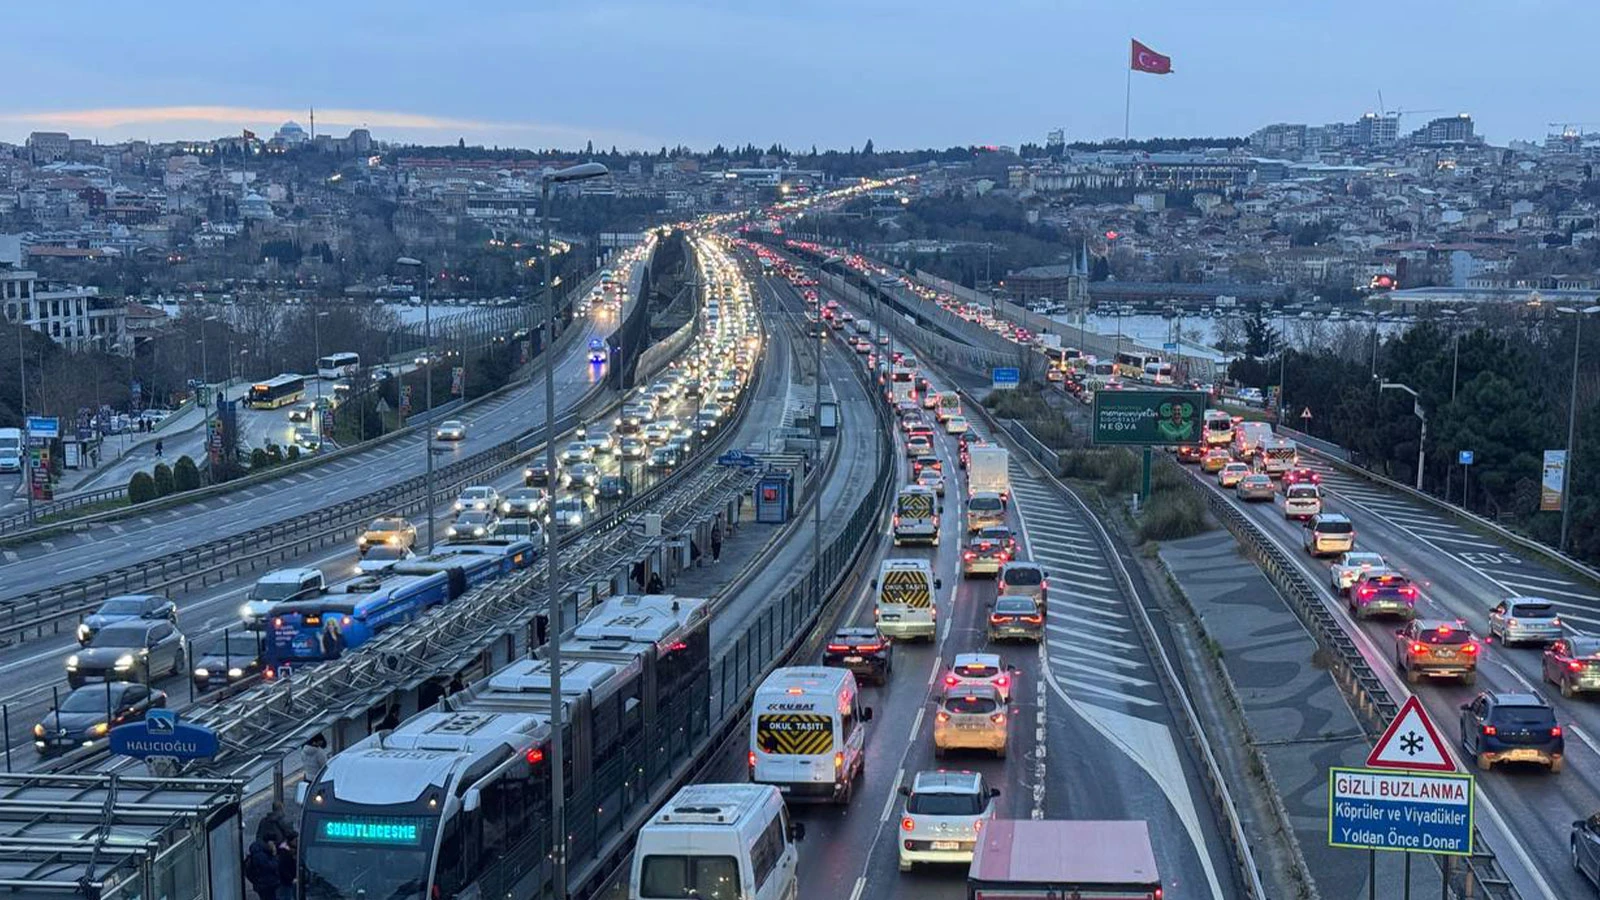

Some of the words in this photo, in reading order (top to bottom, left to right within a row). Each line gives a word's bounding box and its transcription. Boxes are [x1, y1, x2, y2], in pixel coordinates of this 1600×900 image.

[1099, 422, 1137, 431] NEOVA
[1458, 552, 1522, 564] EDS
[769, 722, 792, 731] OKUL
[796, 722, 824, 732] TAŞITI
[126, 740, 197, 752] HALICIOĞLU
[1337, 775, 1375, 795] GİZLİ
[1380, 780, 1465, 800] BUZLANMA
[1335, 801, 1385, 822] Köprüler
[1387, 809, 1401, 820] ve
[1404, 805, 1467, 826] Viyadükler
[1341, 827, 1384, 844] Yoldan
[1388, 827, 1419, 846] Önce
[1423, 833, 1461, 850] Donar
